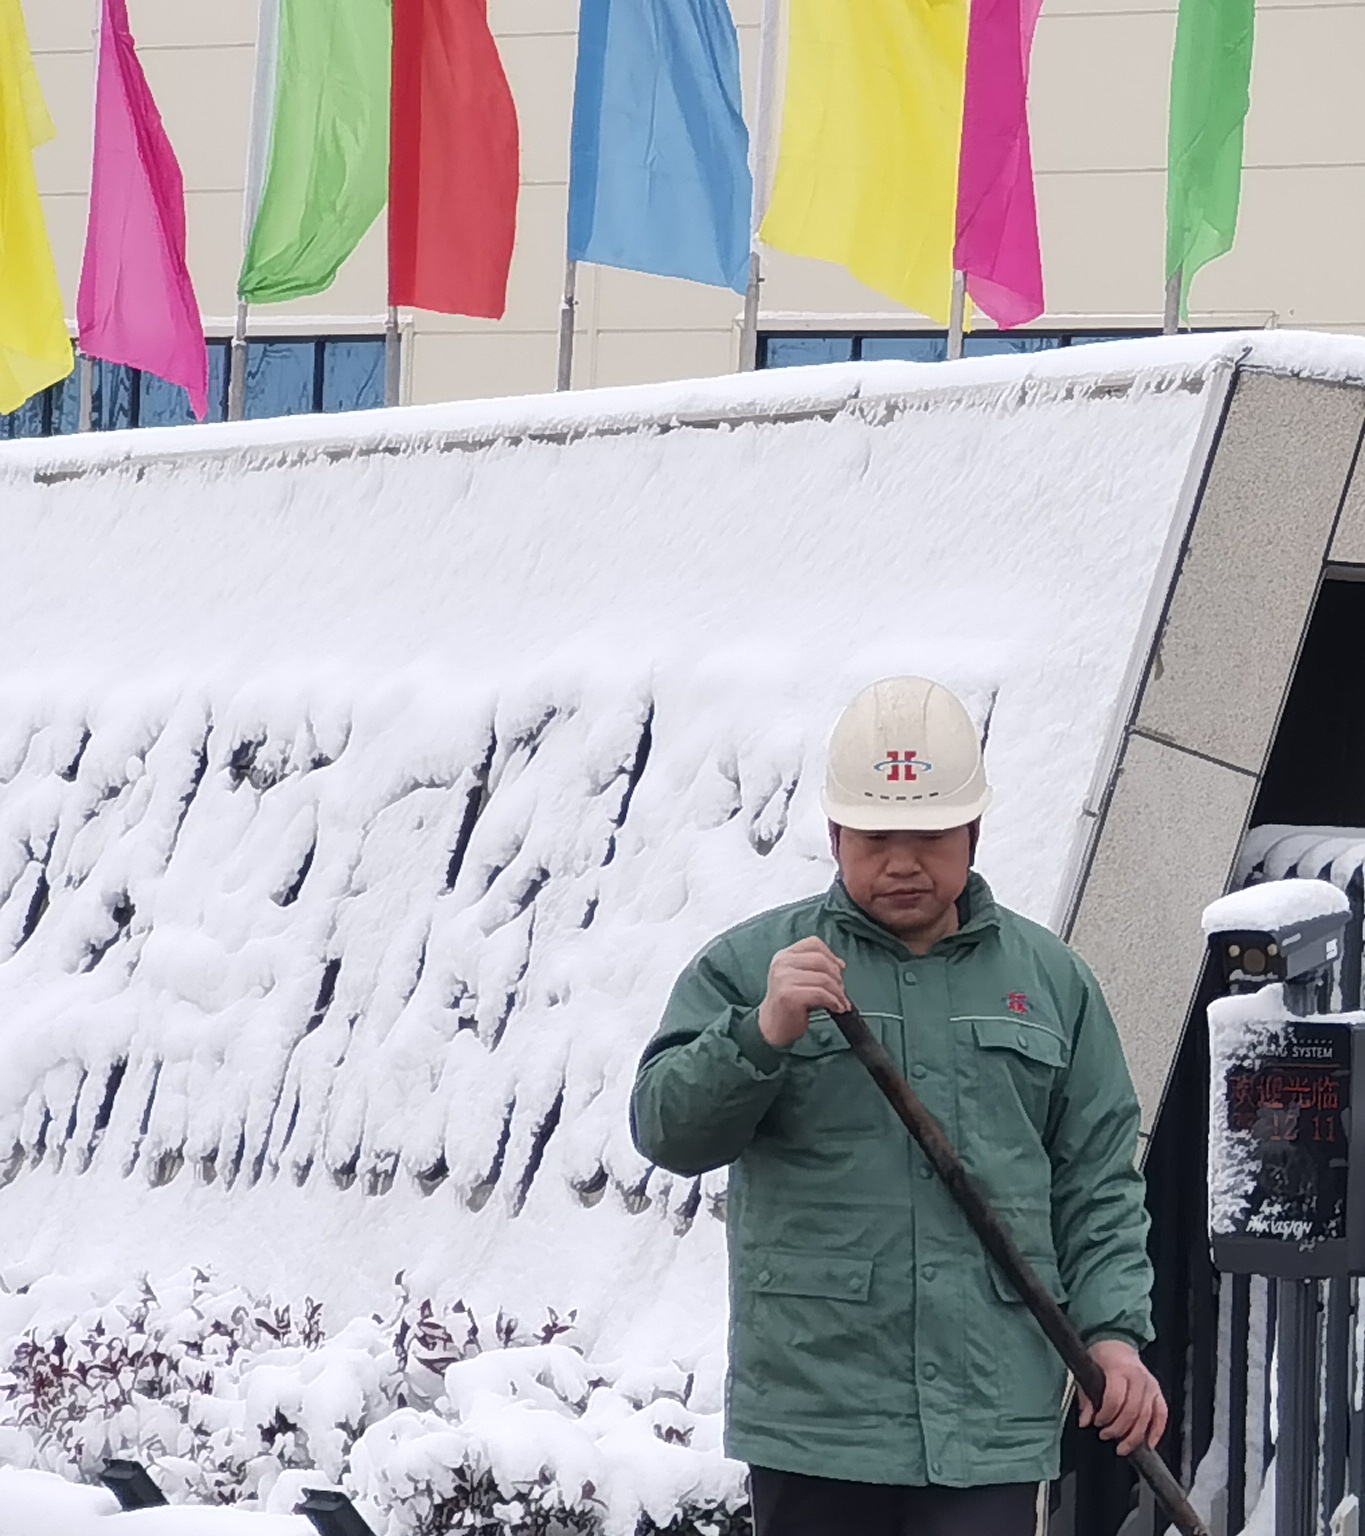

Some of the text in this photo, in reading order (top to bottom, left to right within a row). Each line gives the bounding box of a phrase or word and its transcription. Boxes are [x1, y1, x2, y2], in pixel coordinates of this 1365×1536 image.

[1292, 1045, 1333, 1059] SYSTEM
[1229, 1075, 1339, 1110] 欢迎光临
